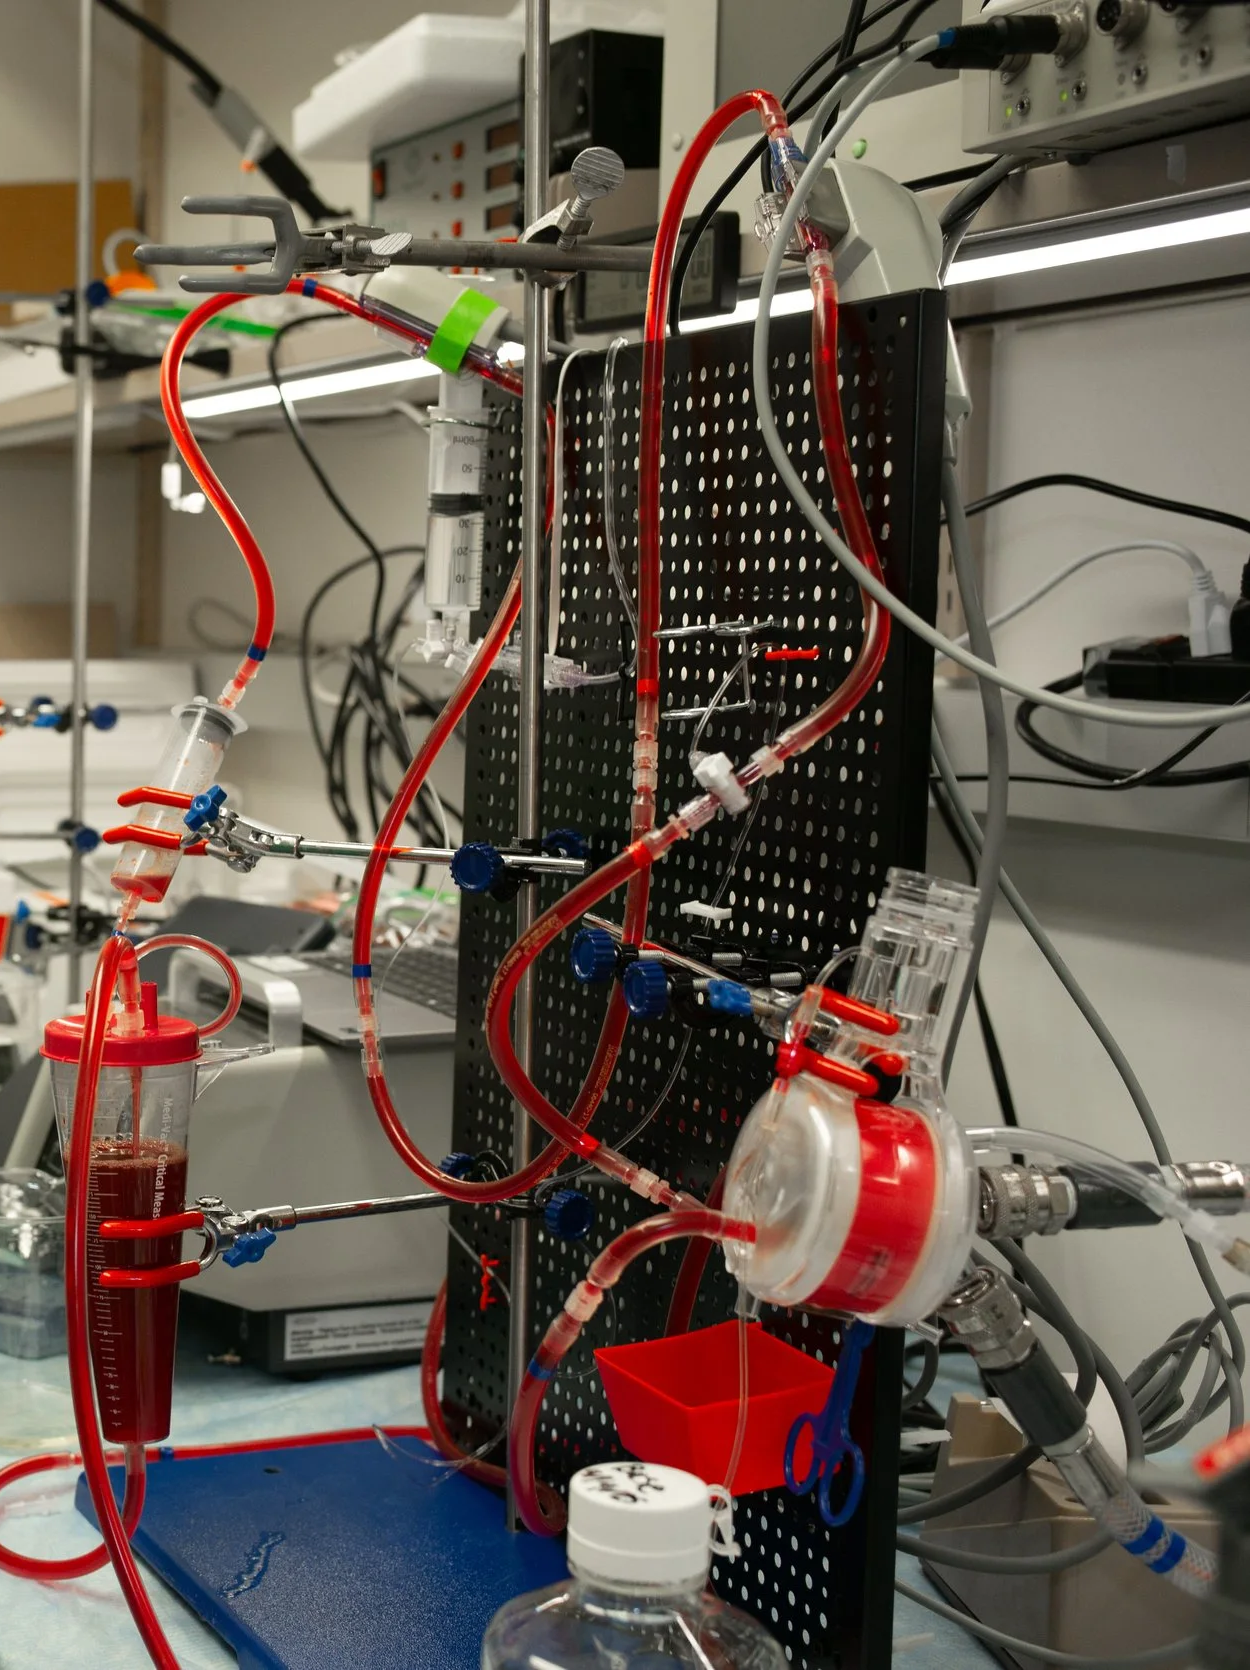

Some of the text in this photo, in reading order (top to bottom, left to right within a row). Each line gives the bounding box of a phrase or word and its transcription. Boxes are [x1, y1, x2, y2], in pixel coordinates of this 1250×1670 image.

[462, 463, 473, 474] 50
[458, 518, 470, 529] 30
[456, 546, 469, 557] 20
[455, 574, 466, 584] 10
[155, 1153, 168, 1190] Critical
[153, 1191, 165, 1221] Meas
